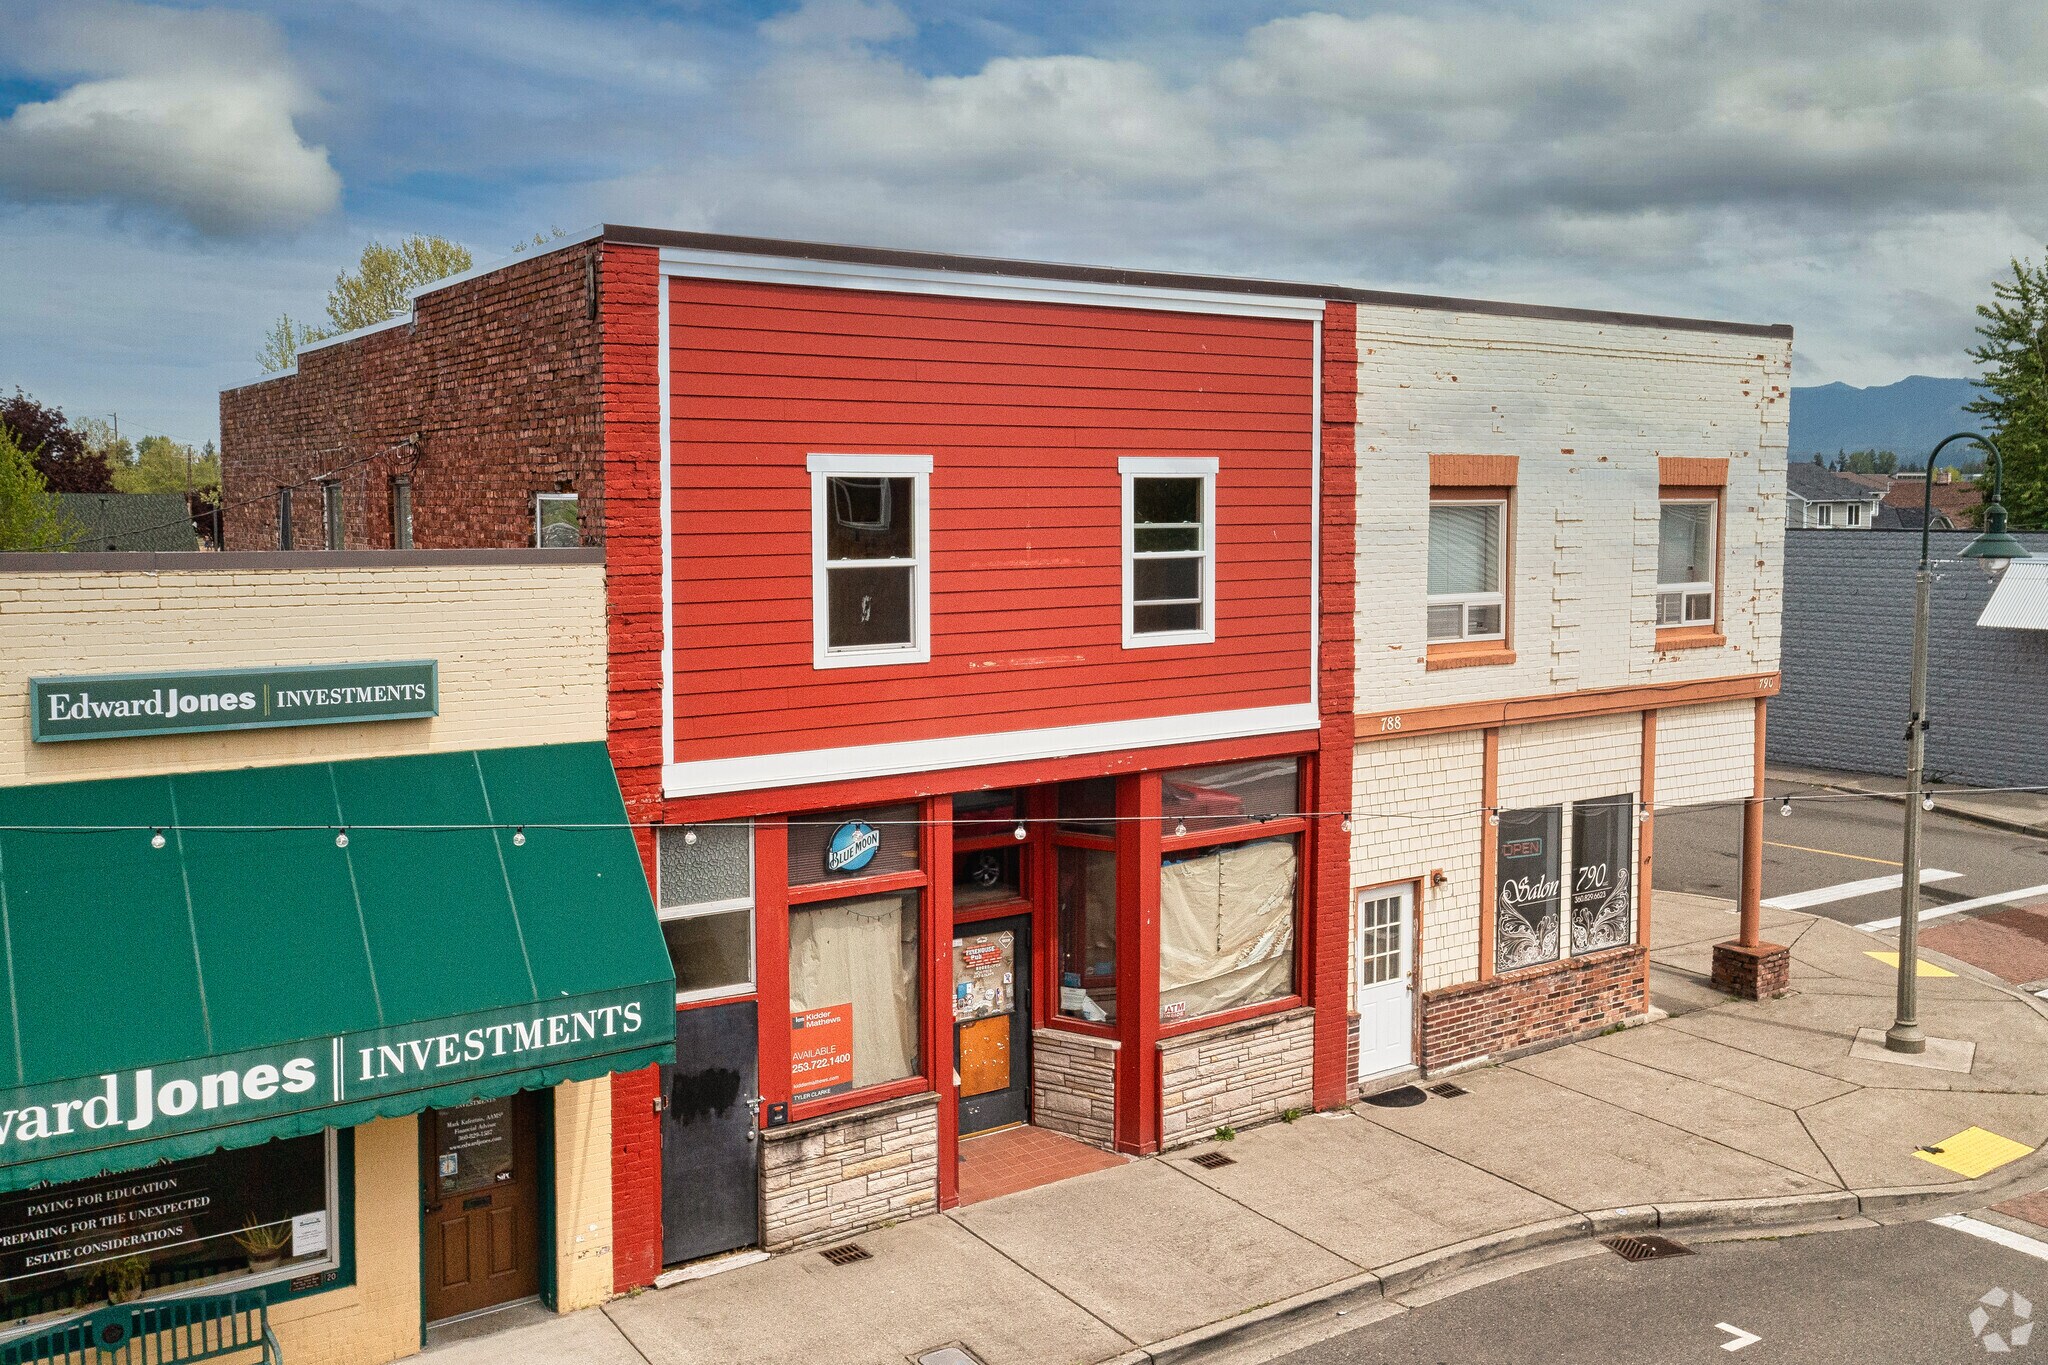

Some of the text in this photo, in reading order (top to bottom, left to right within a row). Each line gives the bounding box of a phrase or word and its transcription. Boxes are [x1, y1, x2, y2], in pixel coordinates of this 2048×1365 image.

[1759, 677, 1773, 689] 790
[276, 683, 426, 708] INVESTMENTS
[1381, 715, 1401, 731] 788
[829, 832, 877, 869] BLUE MOON
[1502, 841, 1539, 857] OPEN
[1503, 863, 1606, 904] Salon 790
[806, 1011, 831, 1021] Kidder
[1165, 1003, 1184, 1013] ATM
[806, 1015, 841, 1028] Mathews
[358, 1001, 643, 1081] INVESTMENTS
[792, 1044, 837, 1061] AVAILABLE
[791, 1053, 851, 1074] 253.722.1400
[794, 1088, 831, 1101] TYLER CLARKE
[454, 1125, 477, 1134] Financial
[27, 1178, 178, 1217] PAYING FOR EDUCATION
[71, 1218, 97, 1234] FOR
[99, 1211, 126, 1227] THE
[129, 1196, 210, 1221] UNEXPECTED
[25, 1225, 183, 1267] ESTATE CONSIDERATIONS
